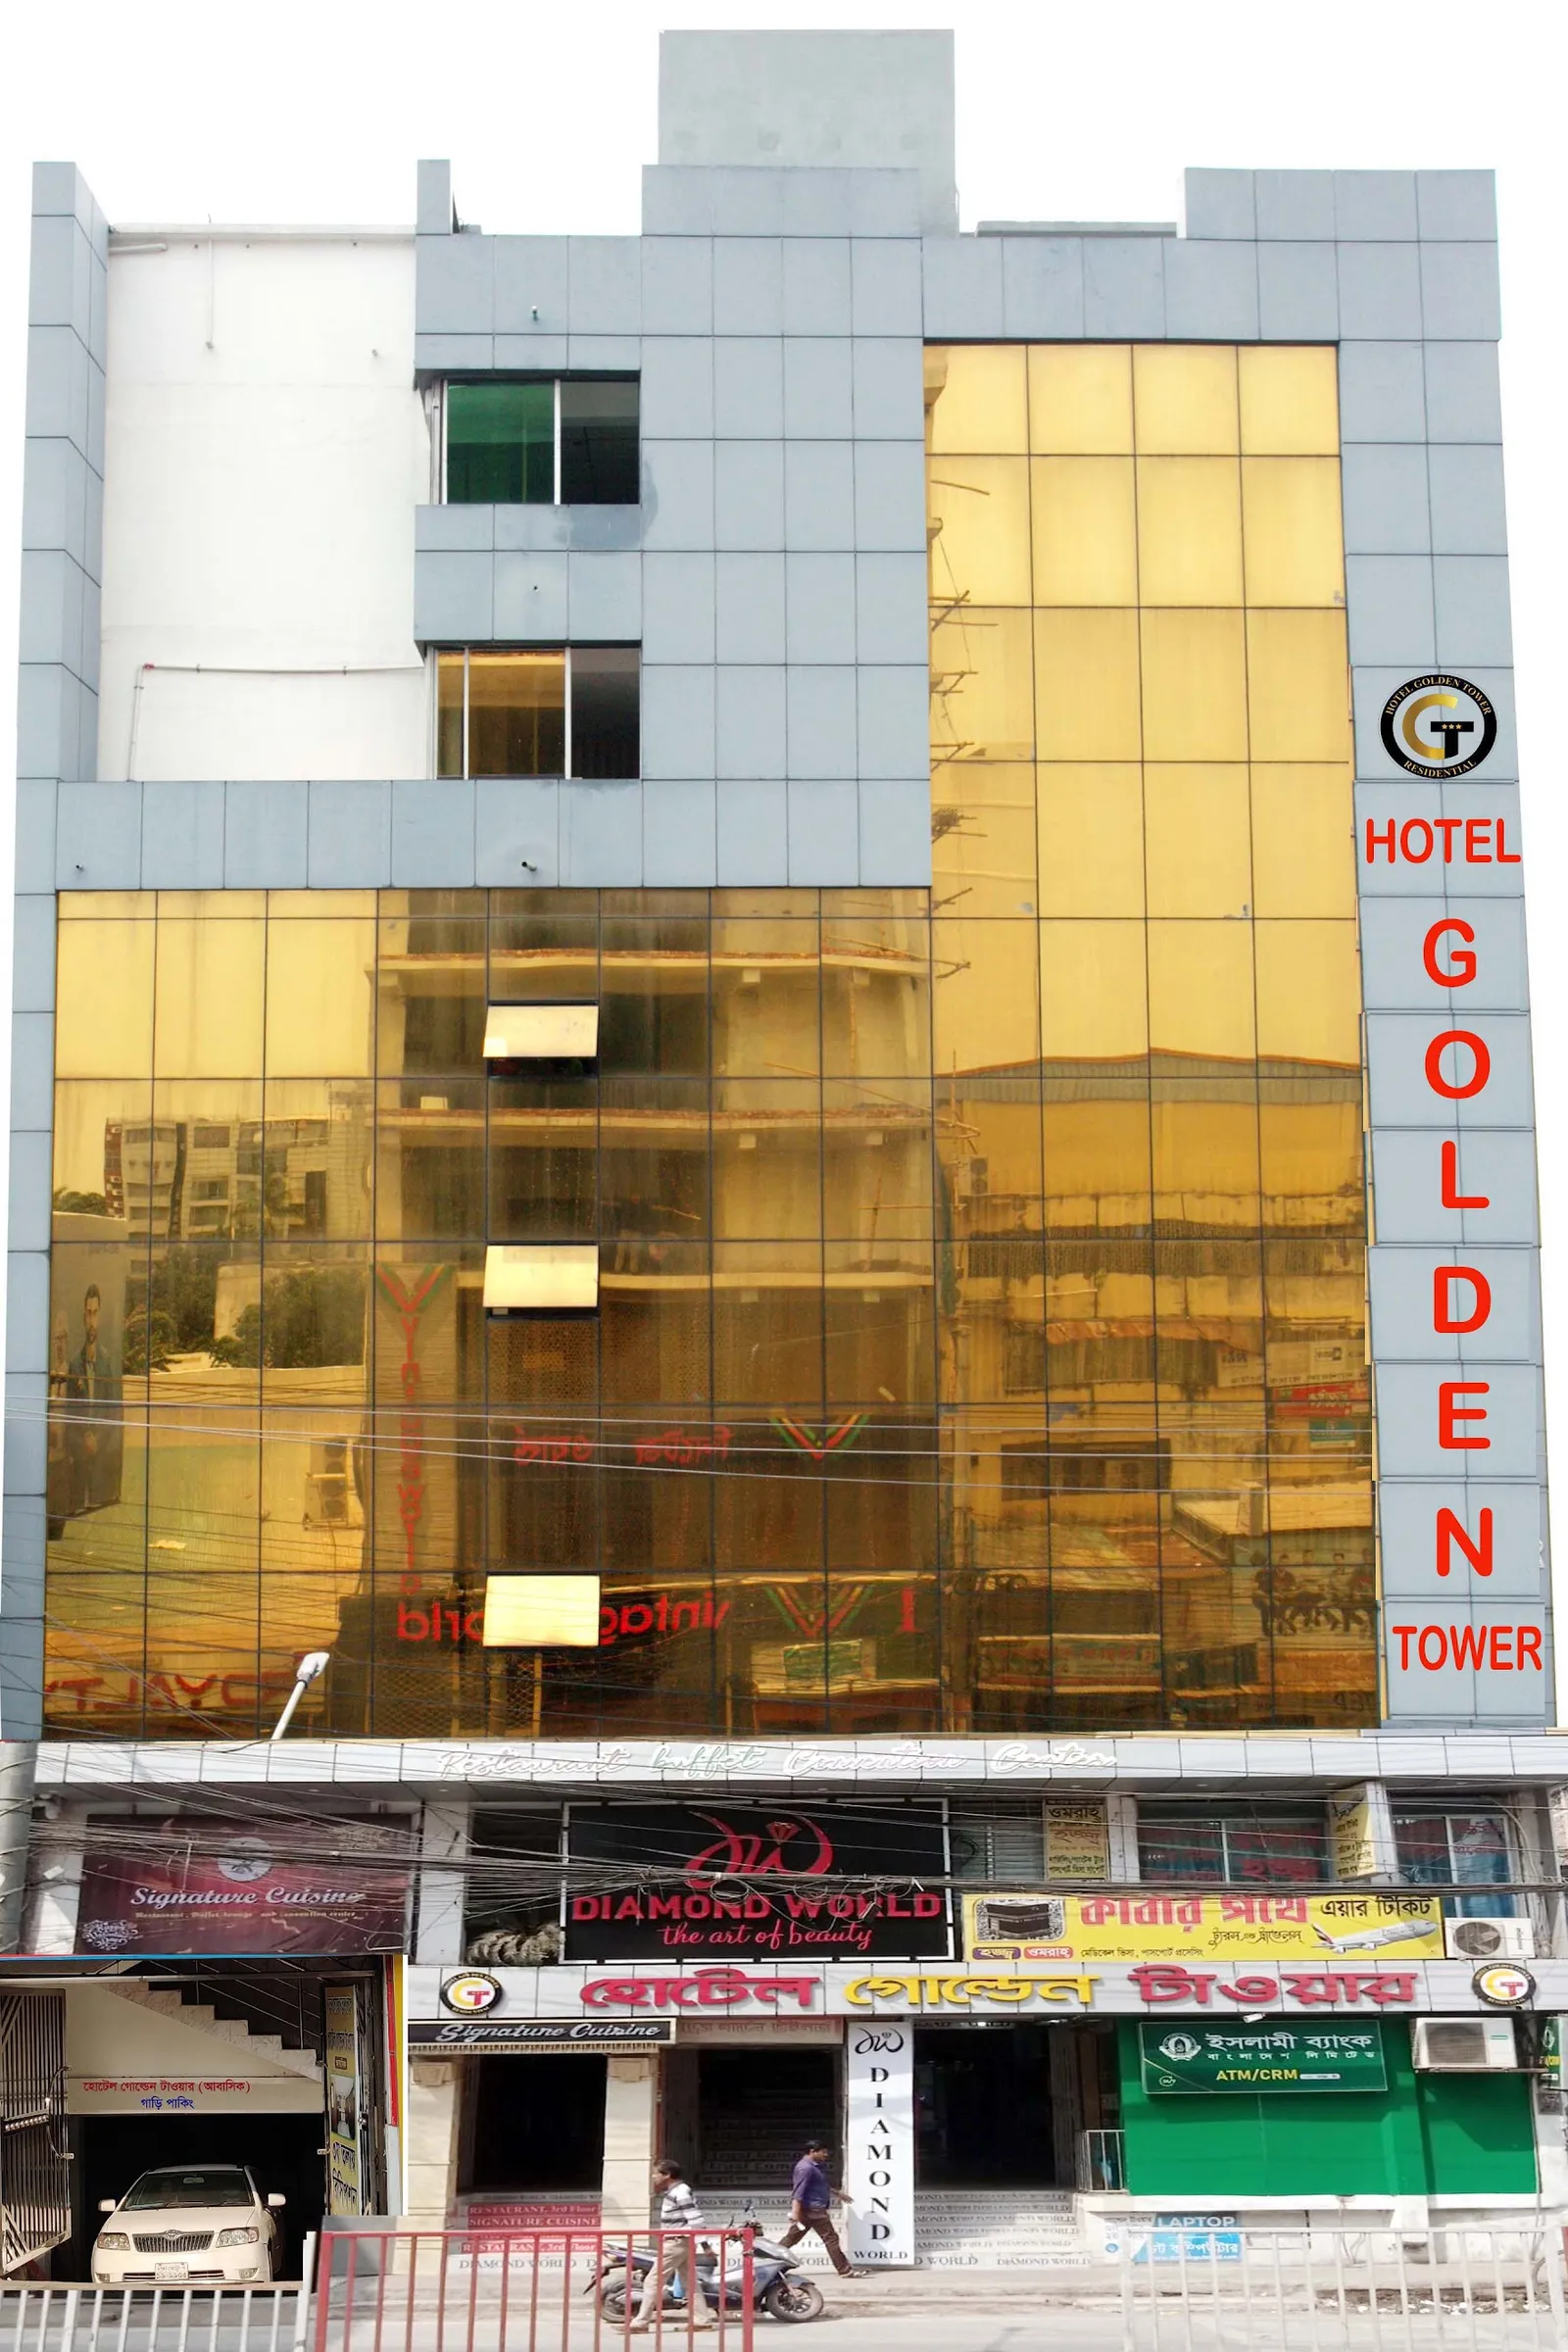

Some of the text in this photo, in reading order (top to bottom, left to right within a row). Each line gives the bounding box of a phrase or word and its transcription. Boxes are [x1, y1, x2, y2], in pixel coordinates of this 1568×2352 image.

[1385, 676, 1493, 716] HOTEL GOLDEN TOWER
[1403, 758, 1477, 779] RESIDENTIAL
[1366, 817, 1521, 864] HOTEL
[1392, 1625, 1543, 1672] TOWER
[129, 1886, 367, 1910] Signature Cuisine
[572, 1891, 942, 1922] DIAMOND WORLD
[1320, 1898, 1368, 1919] এয়ার
[658, 1919, 872, 1951] the art of beauty
[580, 1963, 1420, 2008] হোটেল গোল্ডেন টাওয়ার
[435, 2023, 566, 2044] Signature
[569, 2021, 662, 2041] Cuisine
[1204, 2032, 1375, 2052] ইসলামী ব্যাংক
[1215, 2068, 1298, 2082] ATM/CRM
[83, 2079, 251, 2094] হোটেল গোল্ডেন টাওয়ার (আবাসিক)
[141, 2096, 164, 2110] গাড়ি
[865, 2066, 893, 2242] DIAMOND
[468, 2216, 601, 2227] SIGNATURE CUISINE
[1156, 2216, 1236, 2228] LAPTOP
[854, 2250, 909, 2260] WORLD
